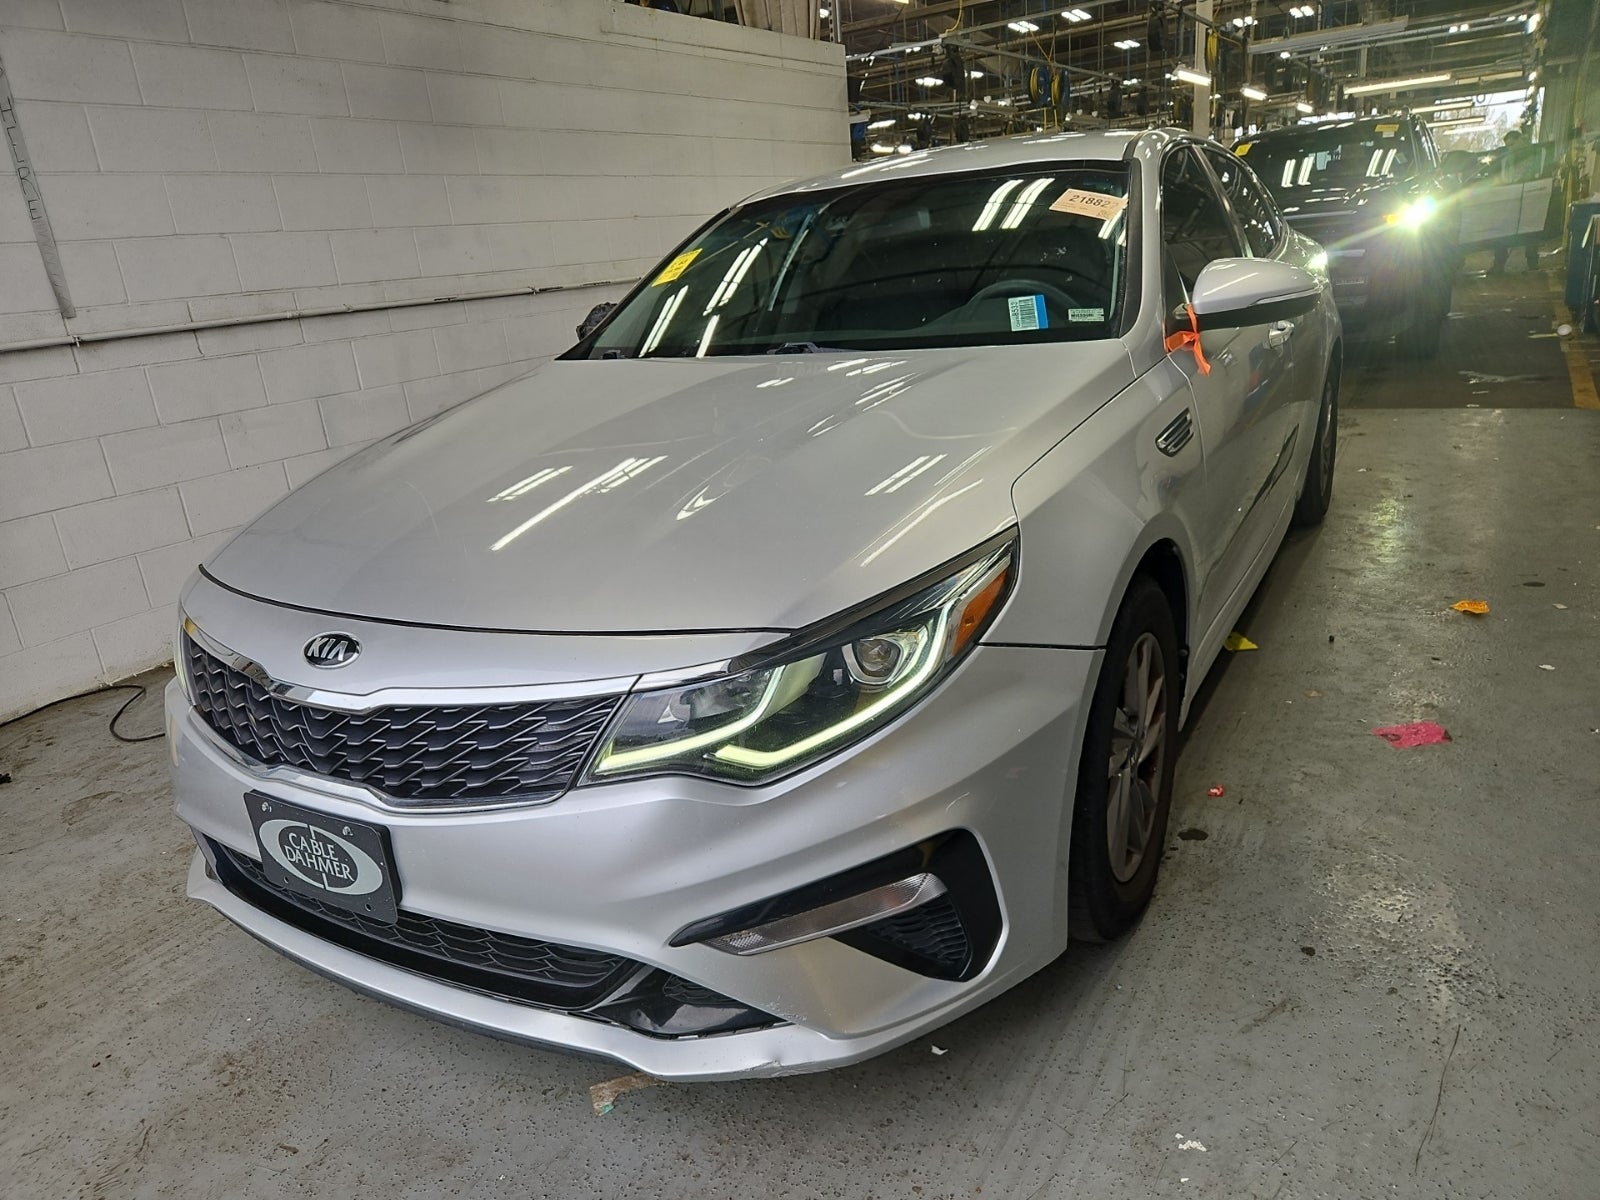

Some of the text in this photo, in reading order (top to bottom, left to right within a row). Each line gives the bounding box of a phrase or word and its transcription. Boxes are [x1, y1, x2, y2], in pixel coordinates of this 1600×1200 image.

[306, 637, 349, 662] KIA
[288, 832, 339, 861] CABLE
[283, 845, 355, 882] DAHMER
